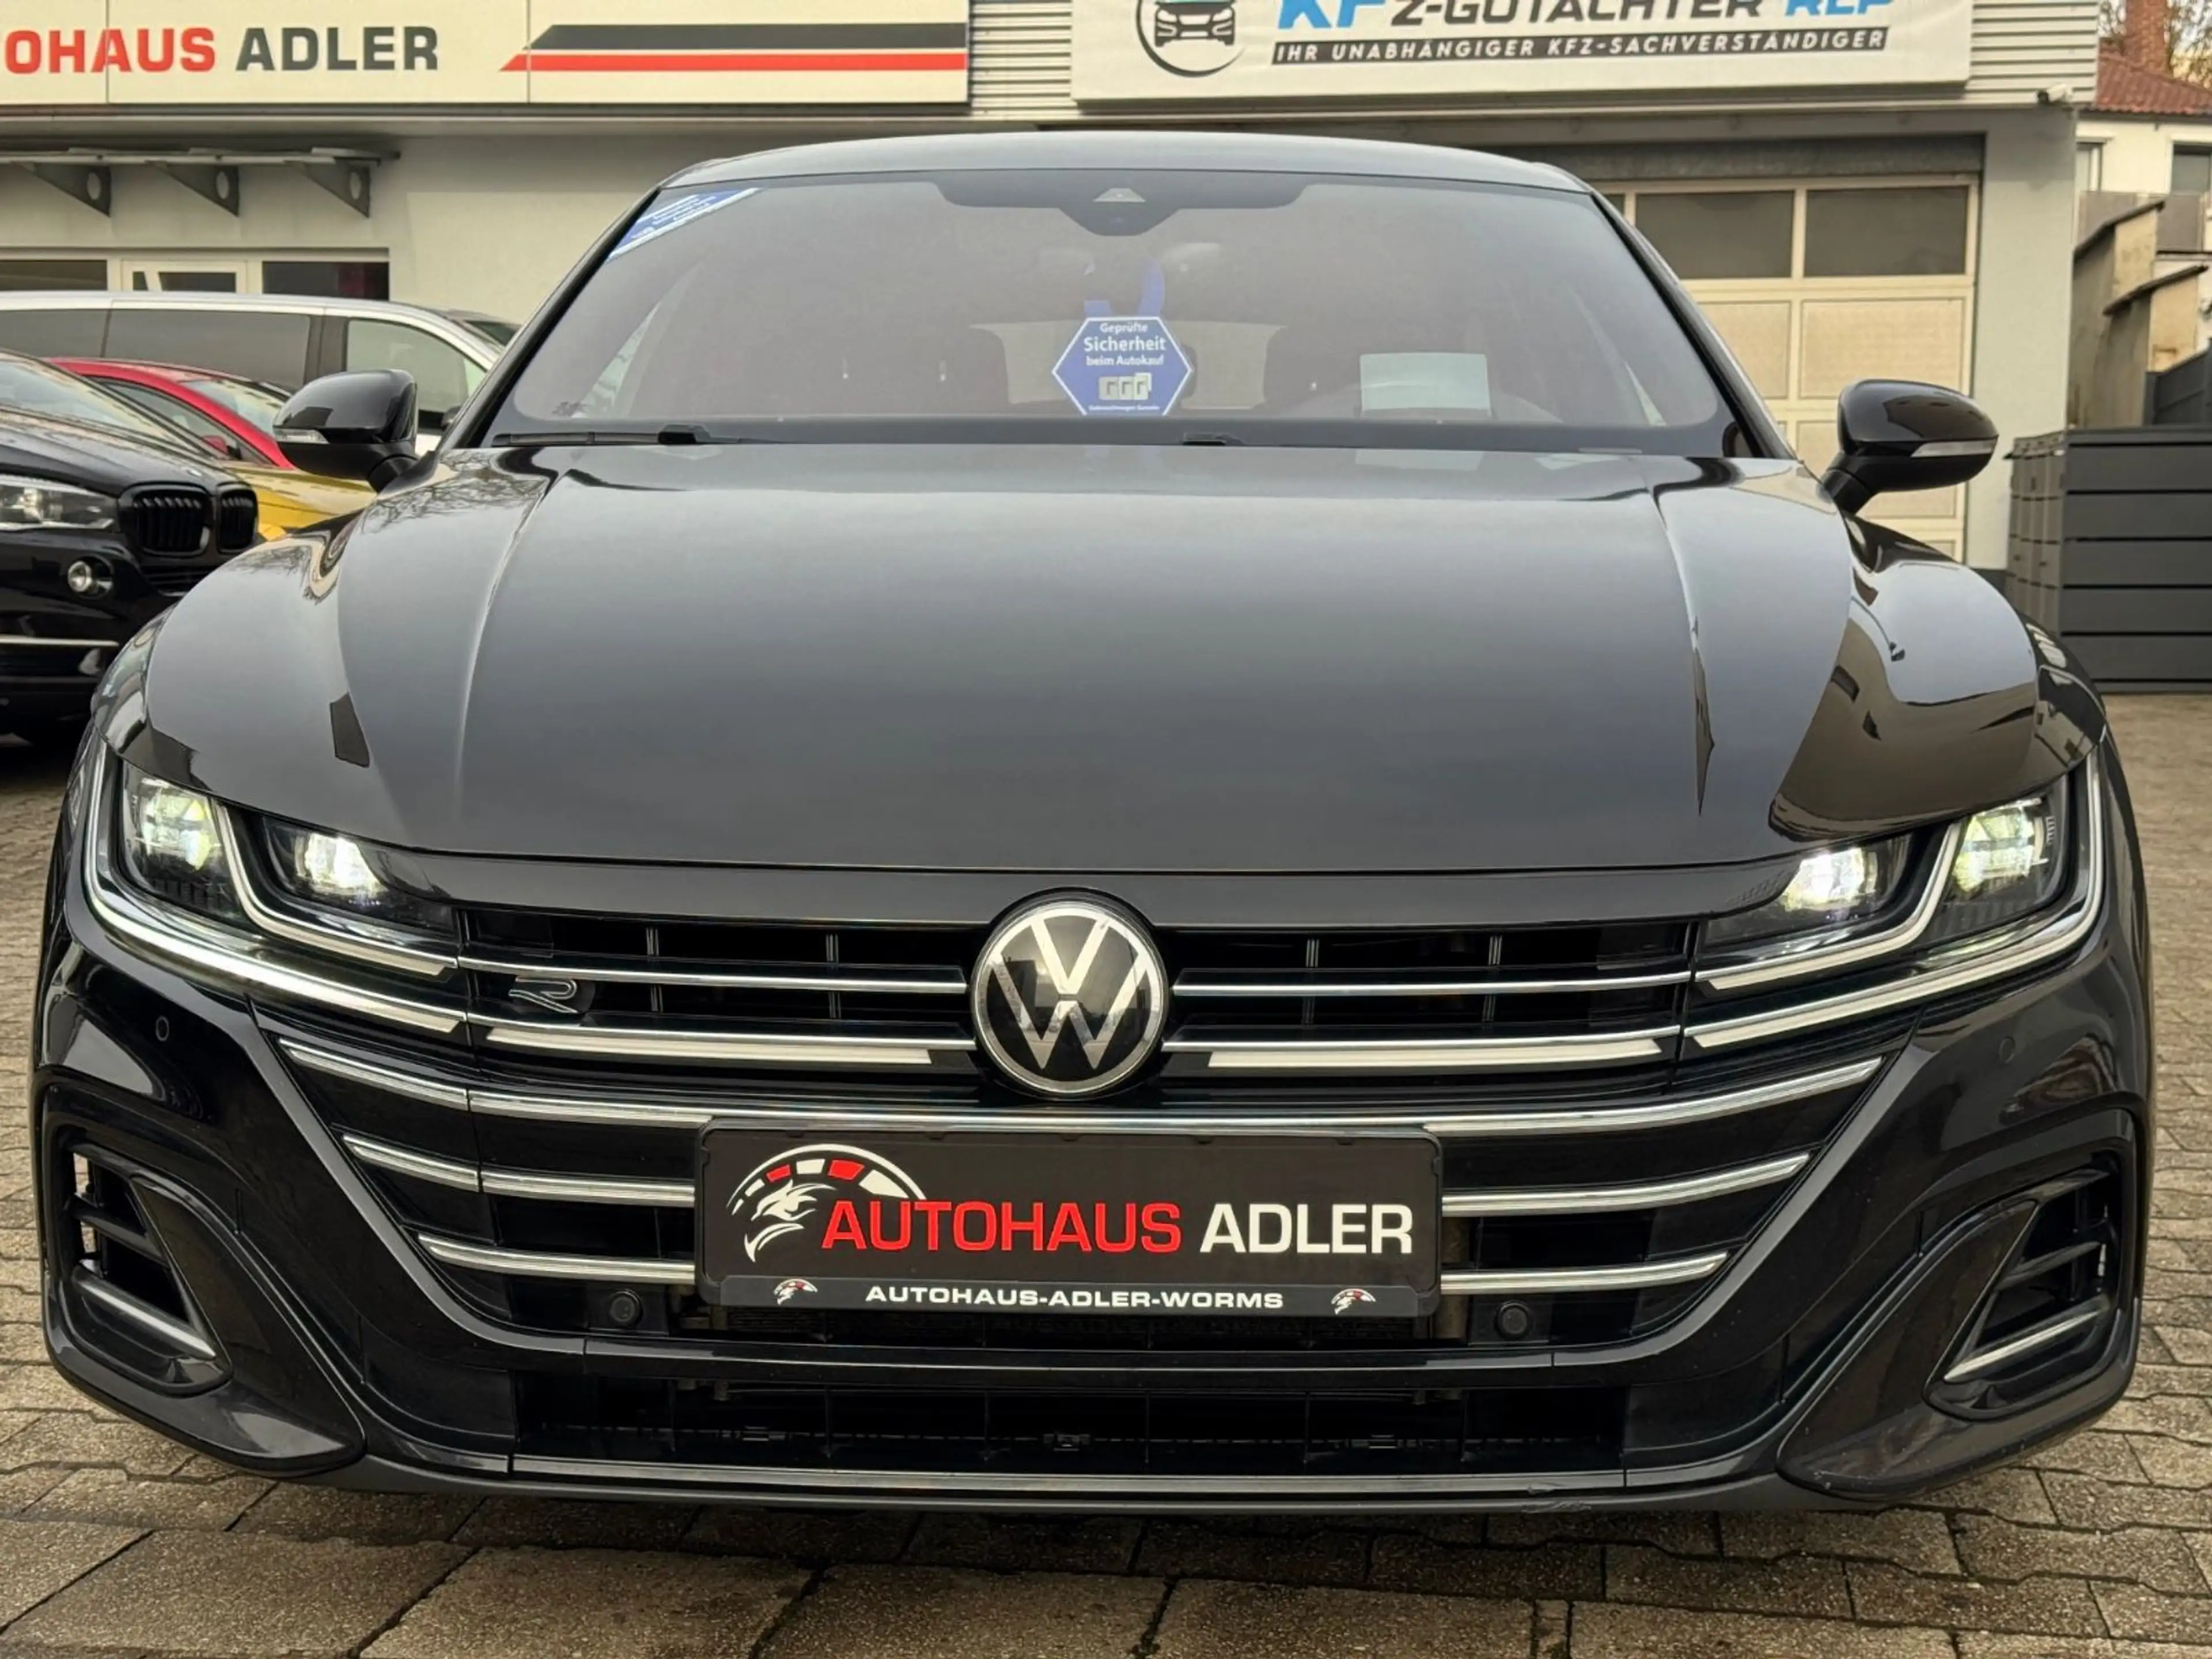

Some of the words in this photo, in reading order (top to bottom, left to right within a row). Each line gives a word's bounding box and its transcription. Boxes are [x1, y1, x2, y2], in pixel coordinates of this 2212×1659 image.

[5, 26, 215, 74] OHAUS
[236, 26, 439, 71] ADLER
[1277, 44, 1318, 62] IHR
[1331, 39, 1535, 60] UNABHÄNGIGER
[1547, 30, 1884, 56] KFZ-SACHVERSTÄNDIGER
[1099, 321, 1149, 335] Geprüfte
[1084, 335, 1167, 352] Sicherheit
[1086, 354, 1115, 366] beim
[1116, 353, 1164, 366] Autokauf
[821, 1200, 1183, 1253] AUTOHAUS
[1199, 1203, 1413, 1254] ADLER
[865, 1285, 1283, 1309] AUTOHAUS-ADLER-WORMS
